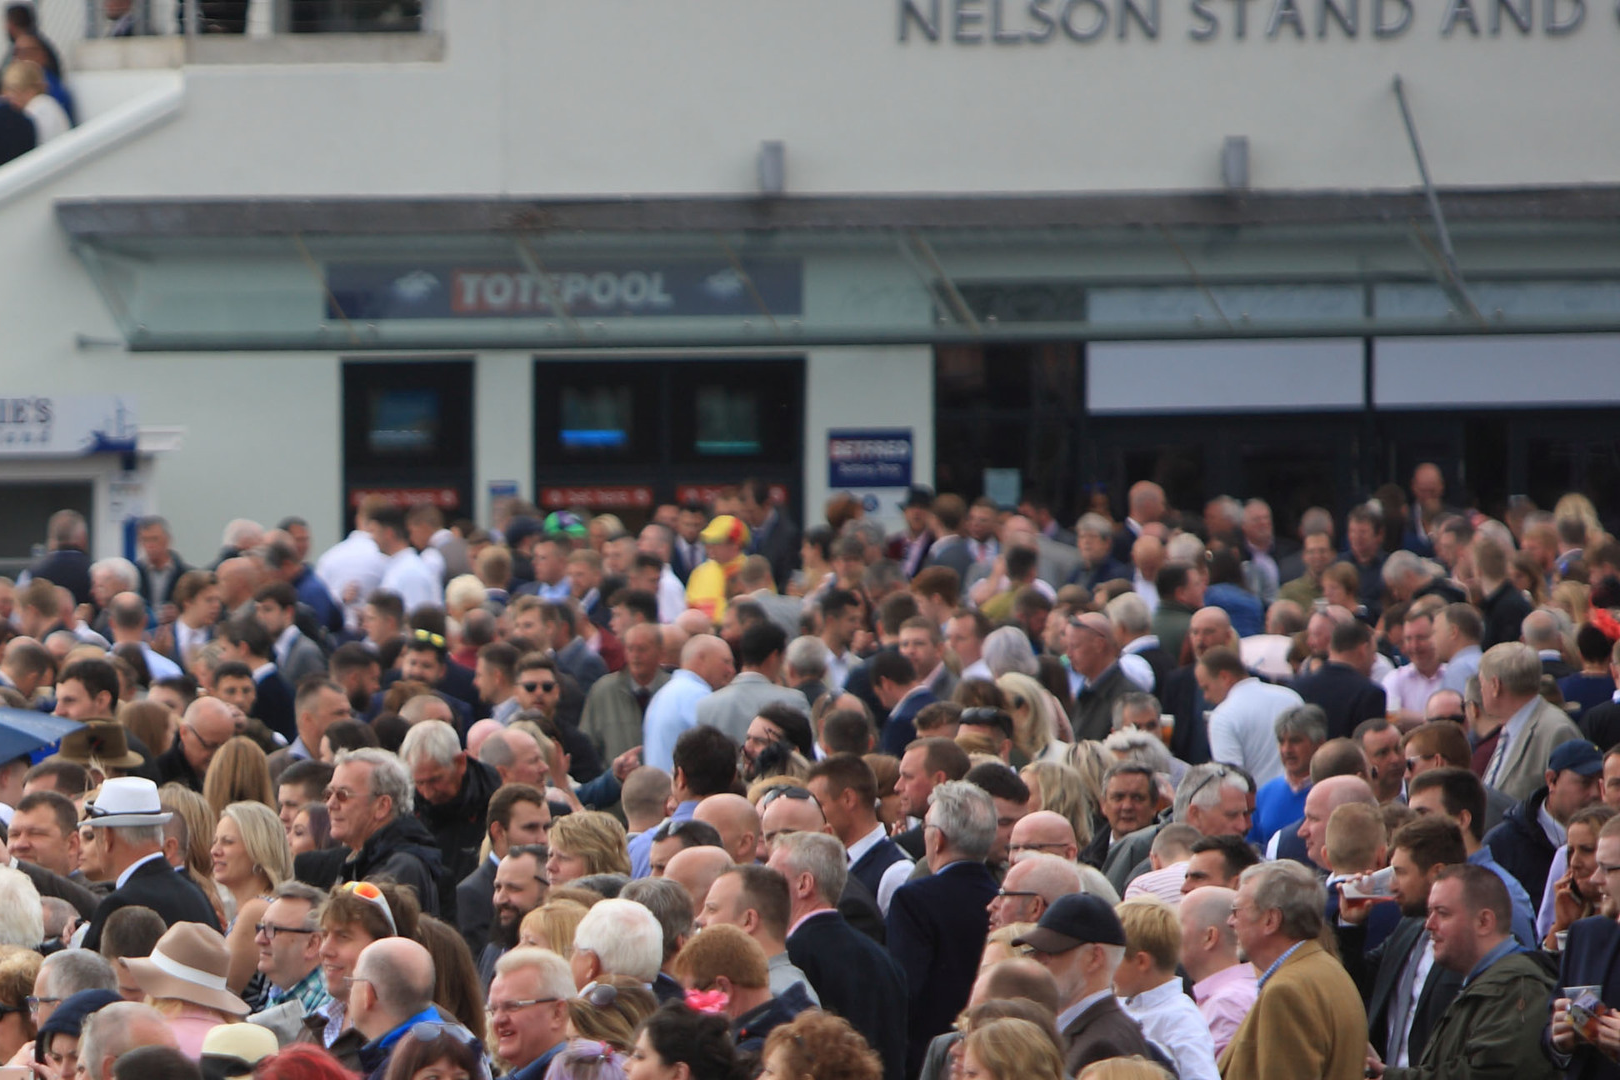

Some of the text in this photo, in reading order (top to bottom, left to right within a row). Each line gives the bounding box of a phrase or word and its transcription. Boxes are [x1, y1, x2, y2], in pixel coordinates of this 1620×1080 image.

[898, 0, 1160, 44] NELSON
[1189, 0, 1414, 41] STAND
[1440, 0, 1585, 39] AND
